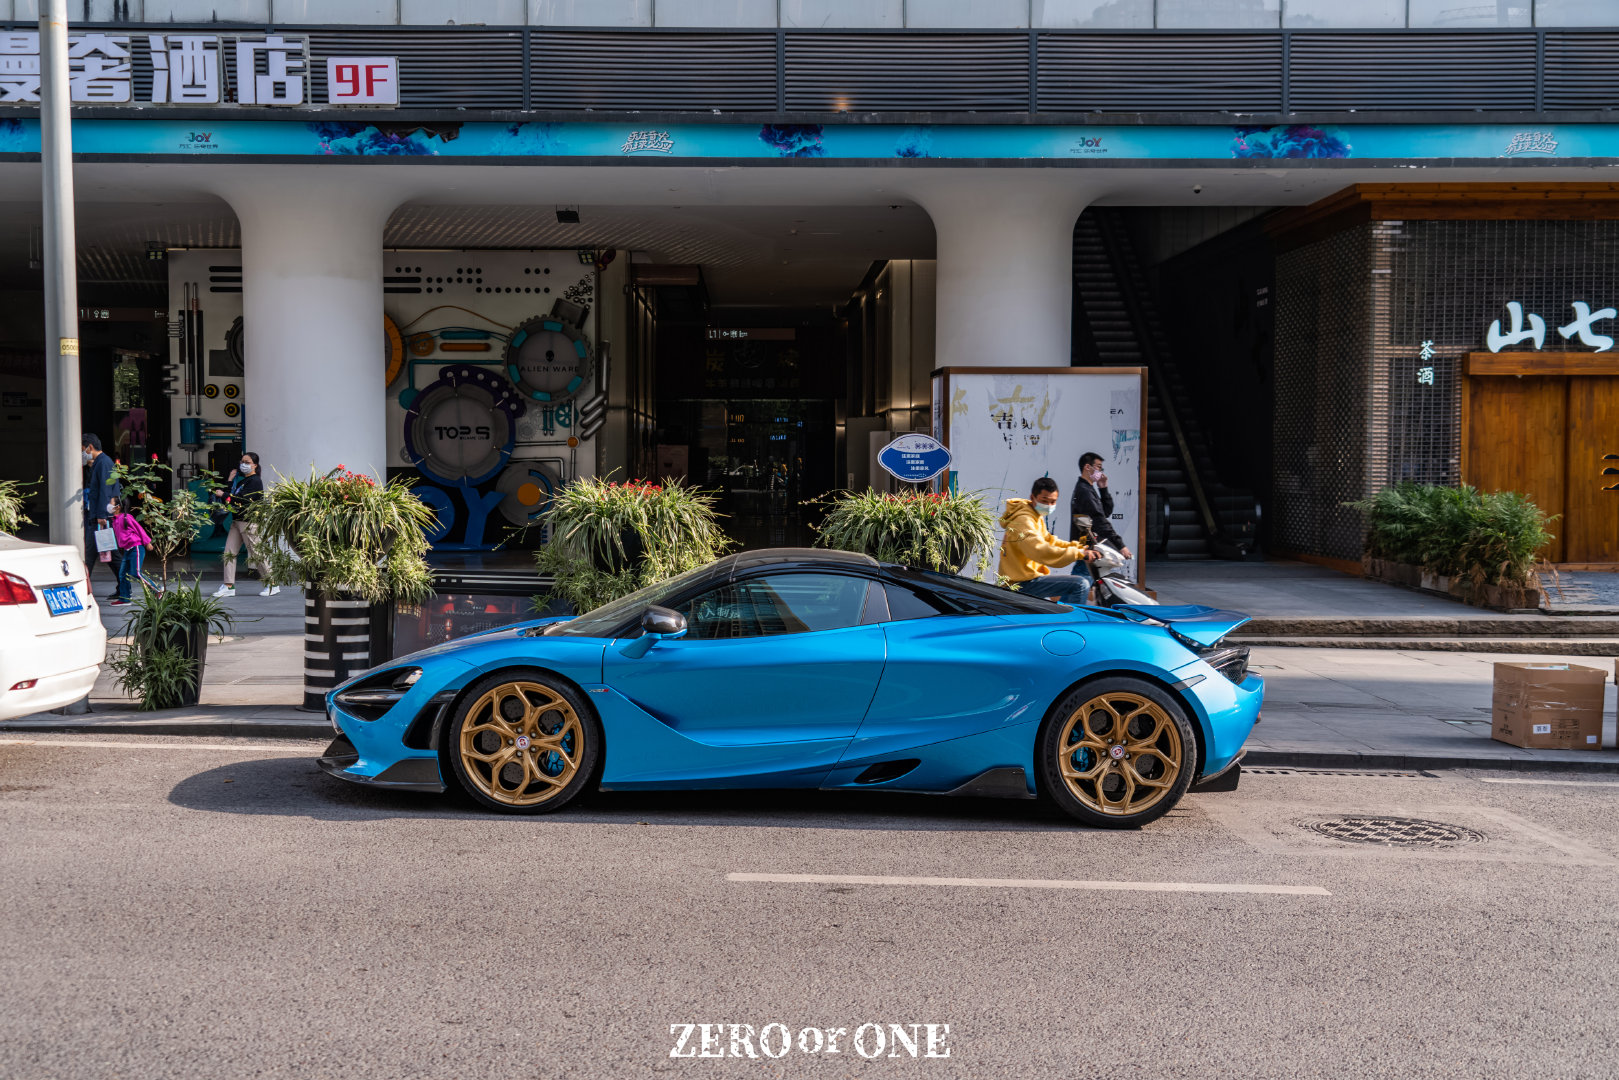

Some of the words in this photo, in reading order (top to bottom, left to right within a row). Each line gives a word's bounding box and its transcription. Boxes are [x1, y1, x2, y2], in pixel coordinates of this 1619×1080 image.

[336, 64, 389, 97] 9F
[1486, 301, 1618, 354] 山七
[1416, 339, 1437, 386] 茶酒
